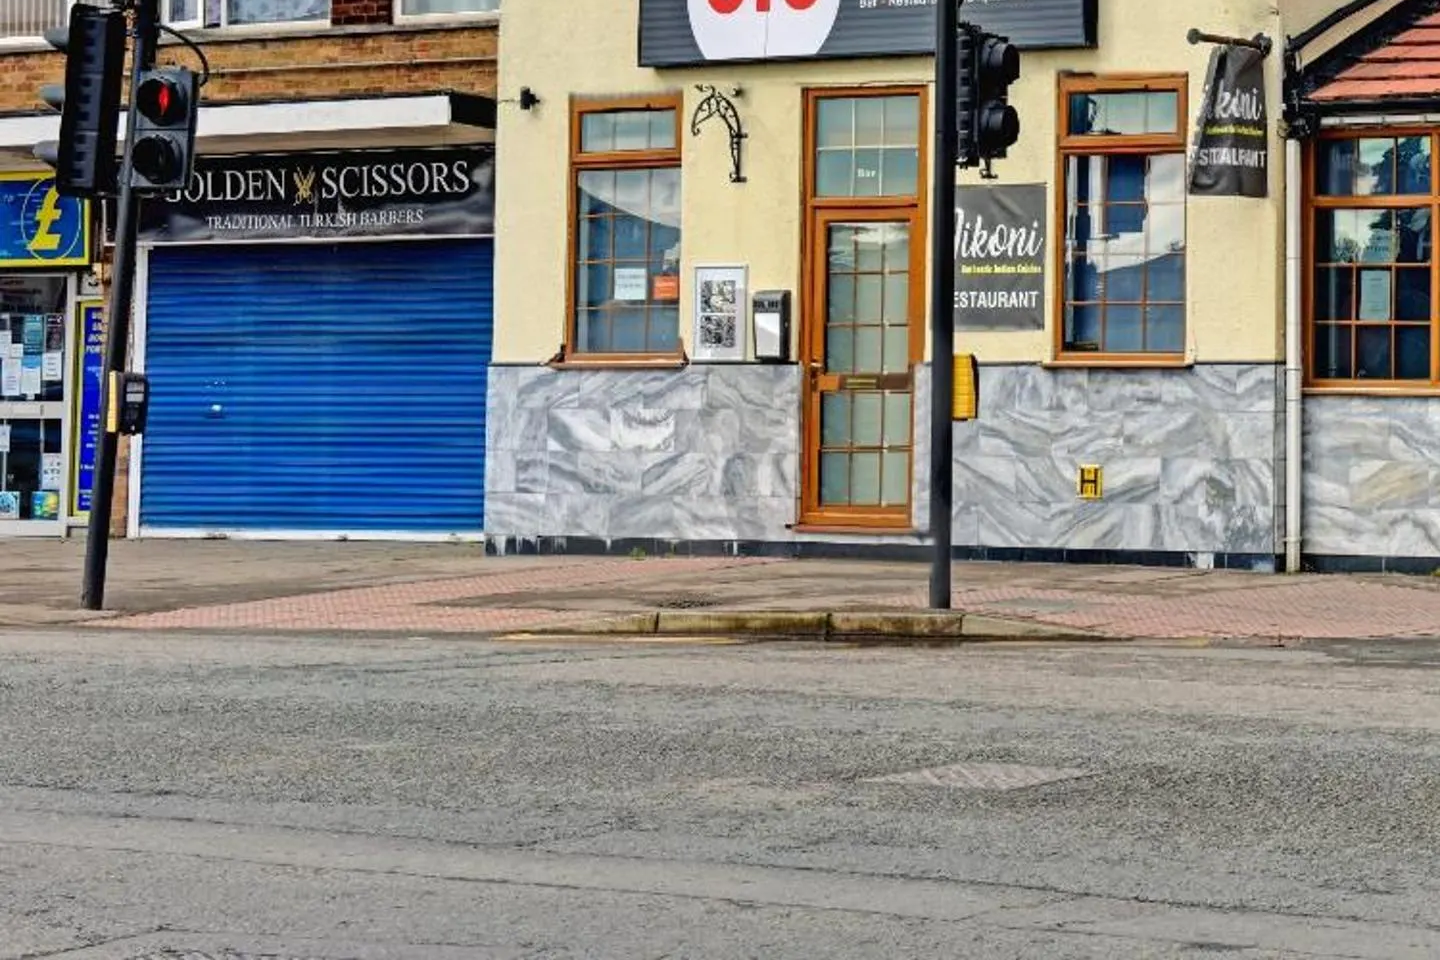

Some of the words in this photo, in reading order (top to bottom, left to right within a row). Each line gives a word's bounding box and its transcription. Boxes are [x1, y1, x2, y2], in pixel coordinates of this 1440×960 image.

[165, 168, 287, 203] OLDEN
[321, 160, 470, 200] SCISSORS
[206, 214, 295, 230] TRADITIONAL
[300, 212, 356, 228] TURKISH
[360, 209, 424, 226] BARBERS
[954, 291, 1039, 309] ESTAURANT
[1080, 467, 1098, 496] H
